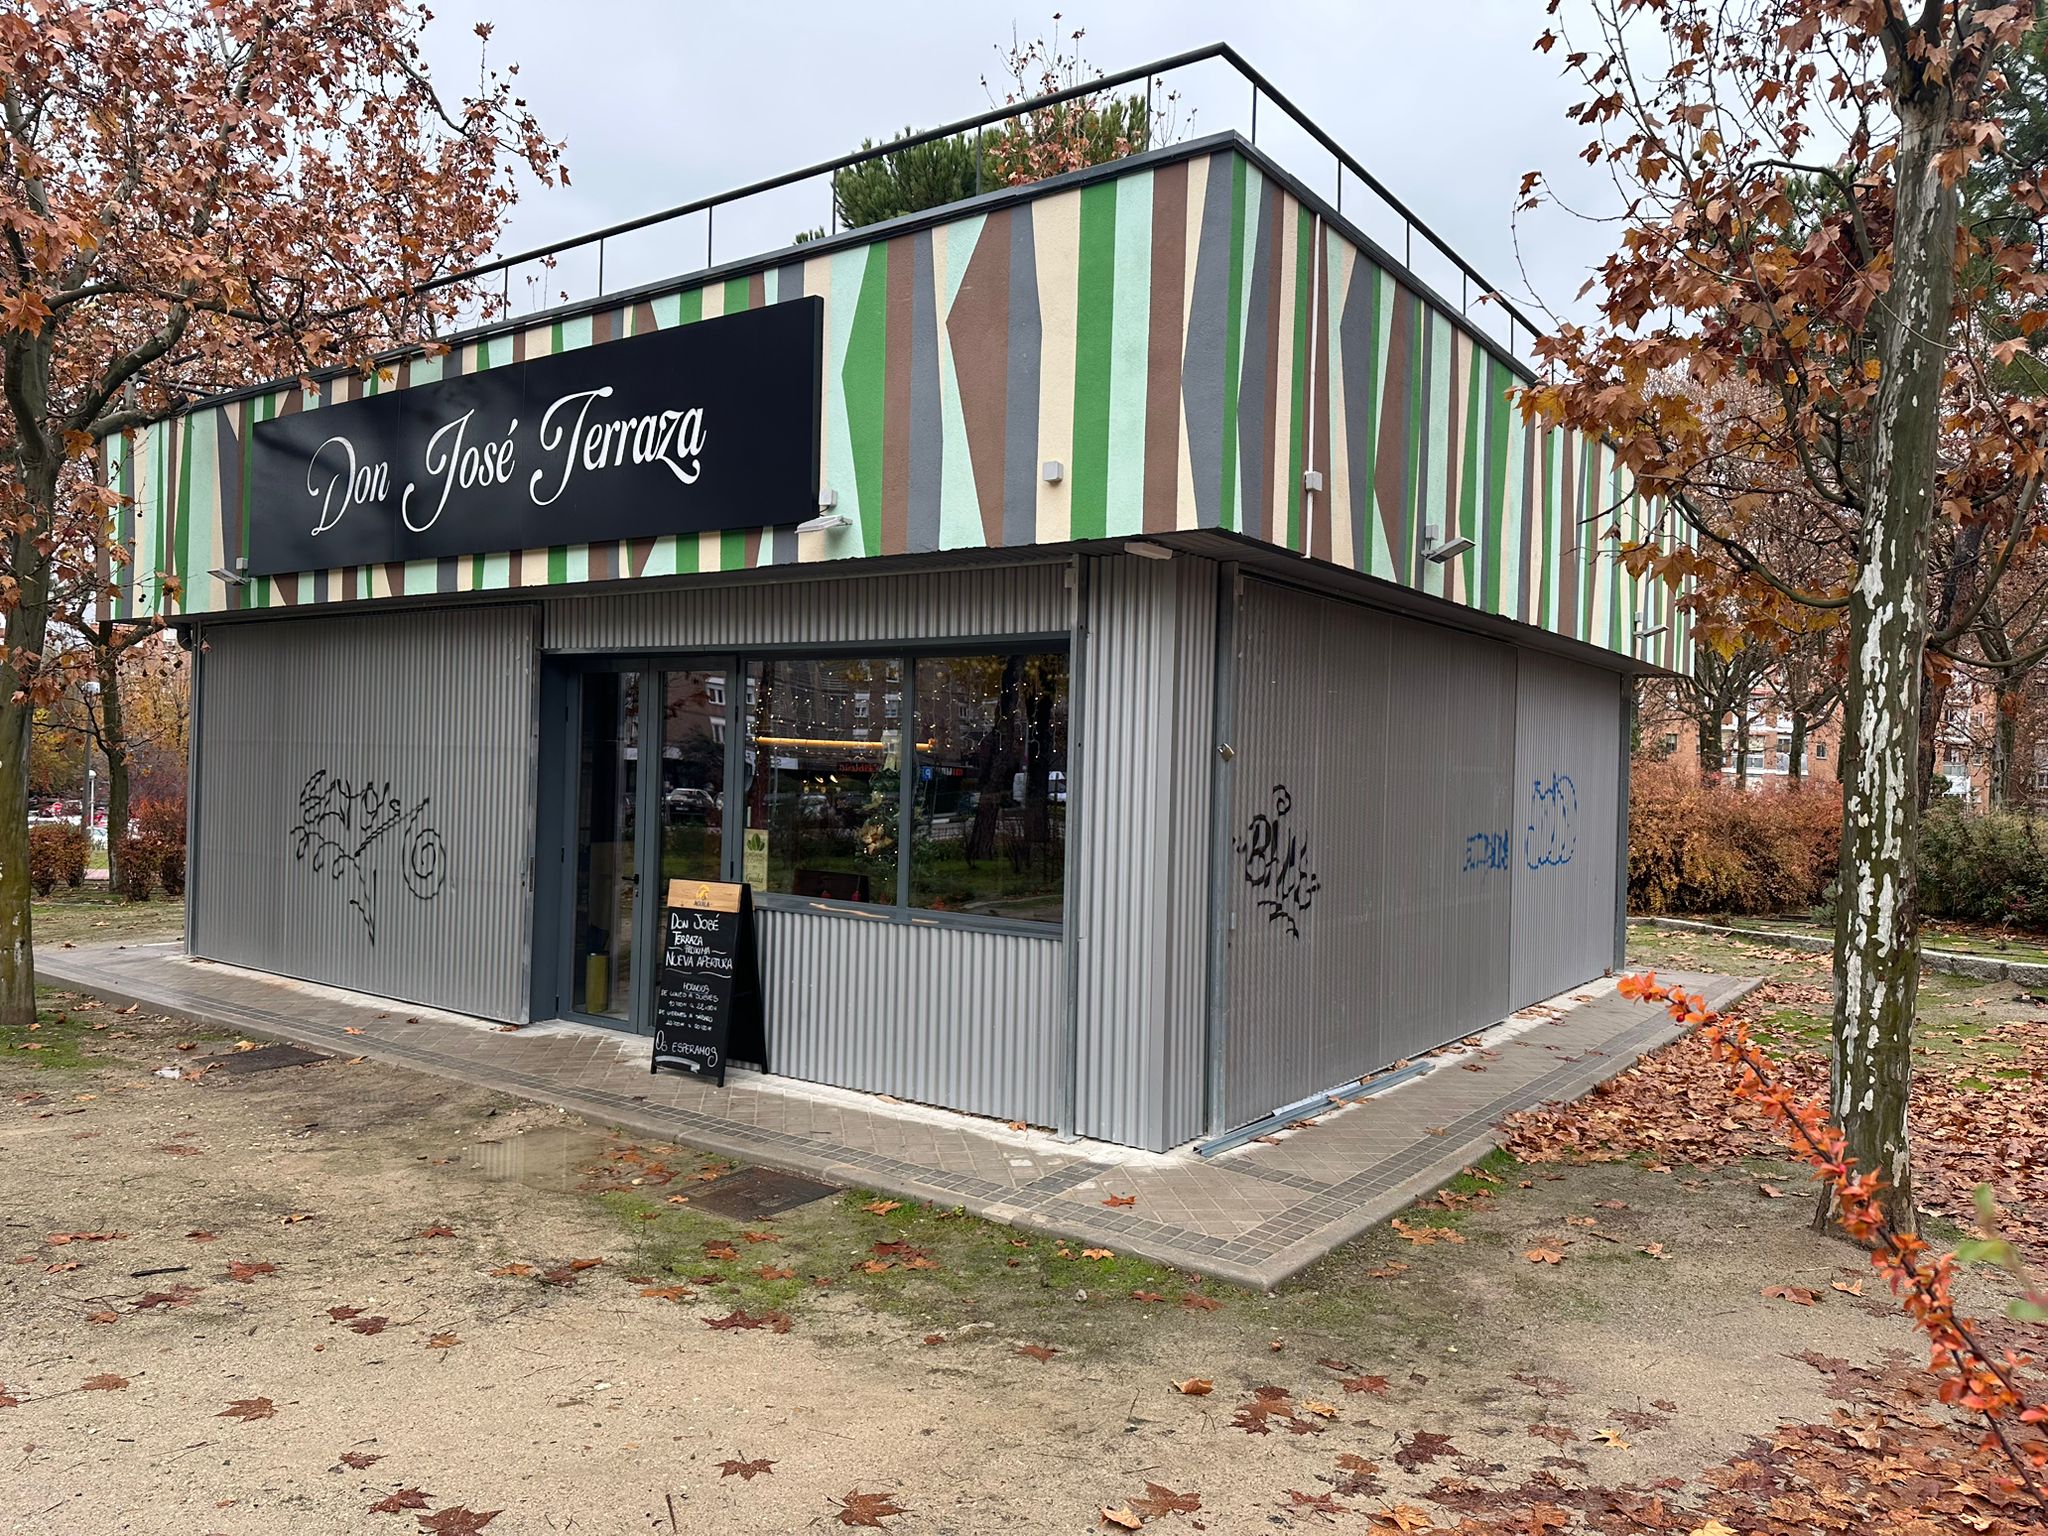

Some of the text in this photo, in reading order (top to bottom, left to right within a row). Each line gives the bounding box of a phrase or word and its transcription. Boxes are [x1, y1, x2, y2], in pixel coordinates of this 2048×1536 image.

[306, 386, 707, 537] Don José Terraza
[672, 930, 703, 946] TERRAZA
[665, 950, 733, 970] NUEVA APERTURA
[671, 1042, 718, 1068] ESPERAMOS
